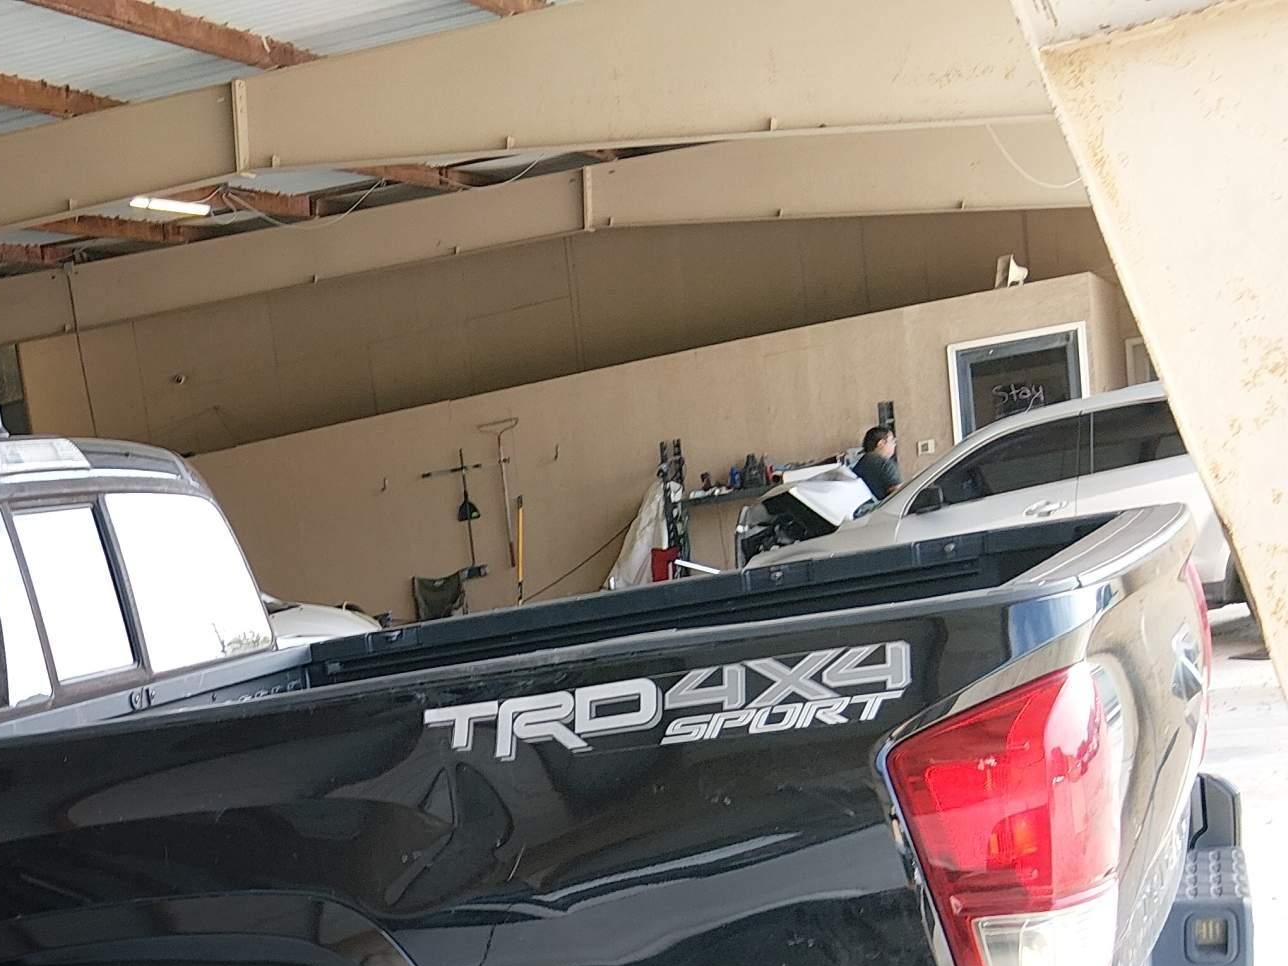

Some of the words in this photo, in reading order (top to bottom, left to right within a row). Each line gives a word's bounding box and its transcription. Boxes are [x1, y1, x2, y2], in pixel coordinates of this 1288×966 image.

[992, 384, 1045, 412] Stay
[423, 678, 663, 761] TRD
[664, 640, 912, 709] 4X4
[659, 690, 904, 745] SPORT
